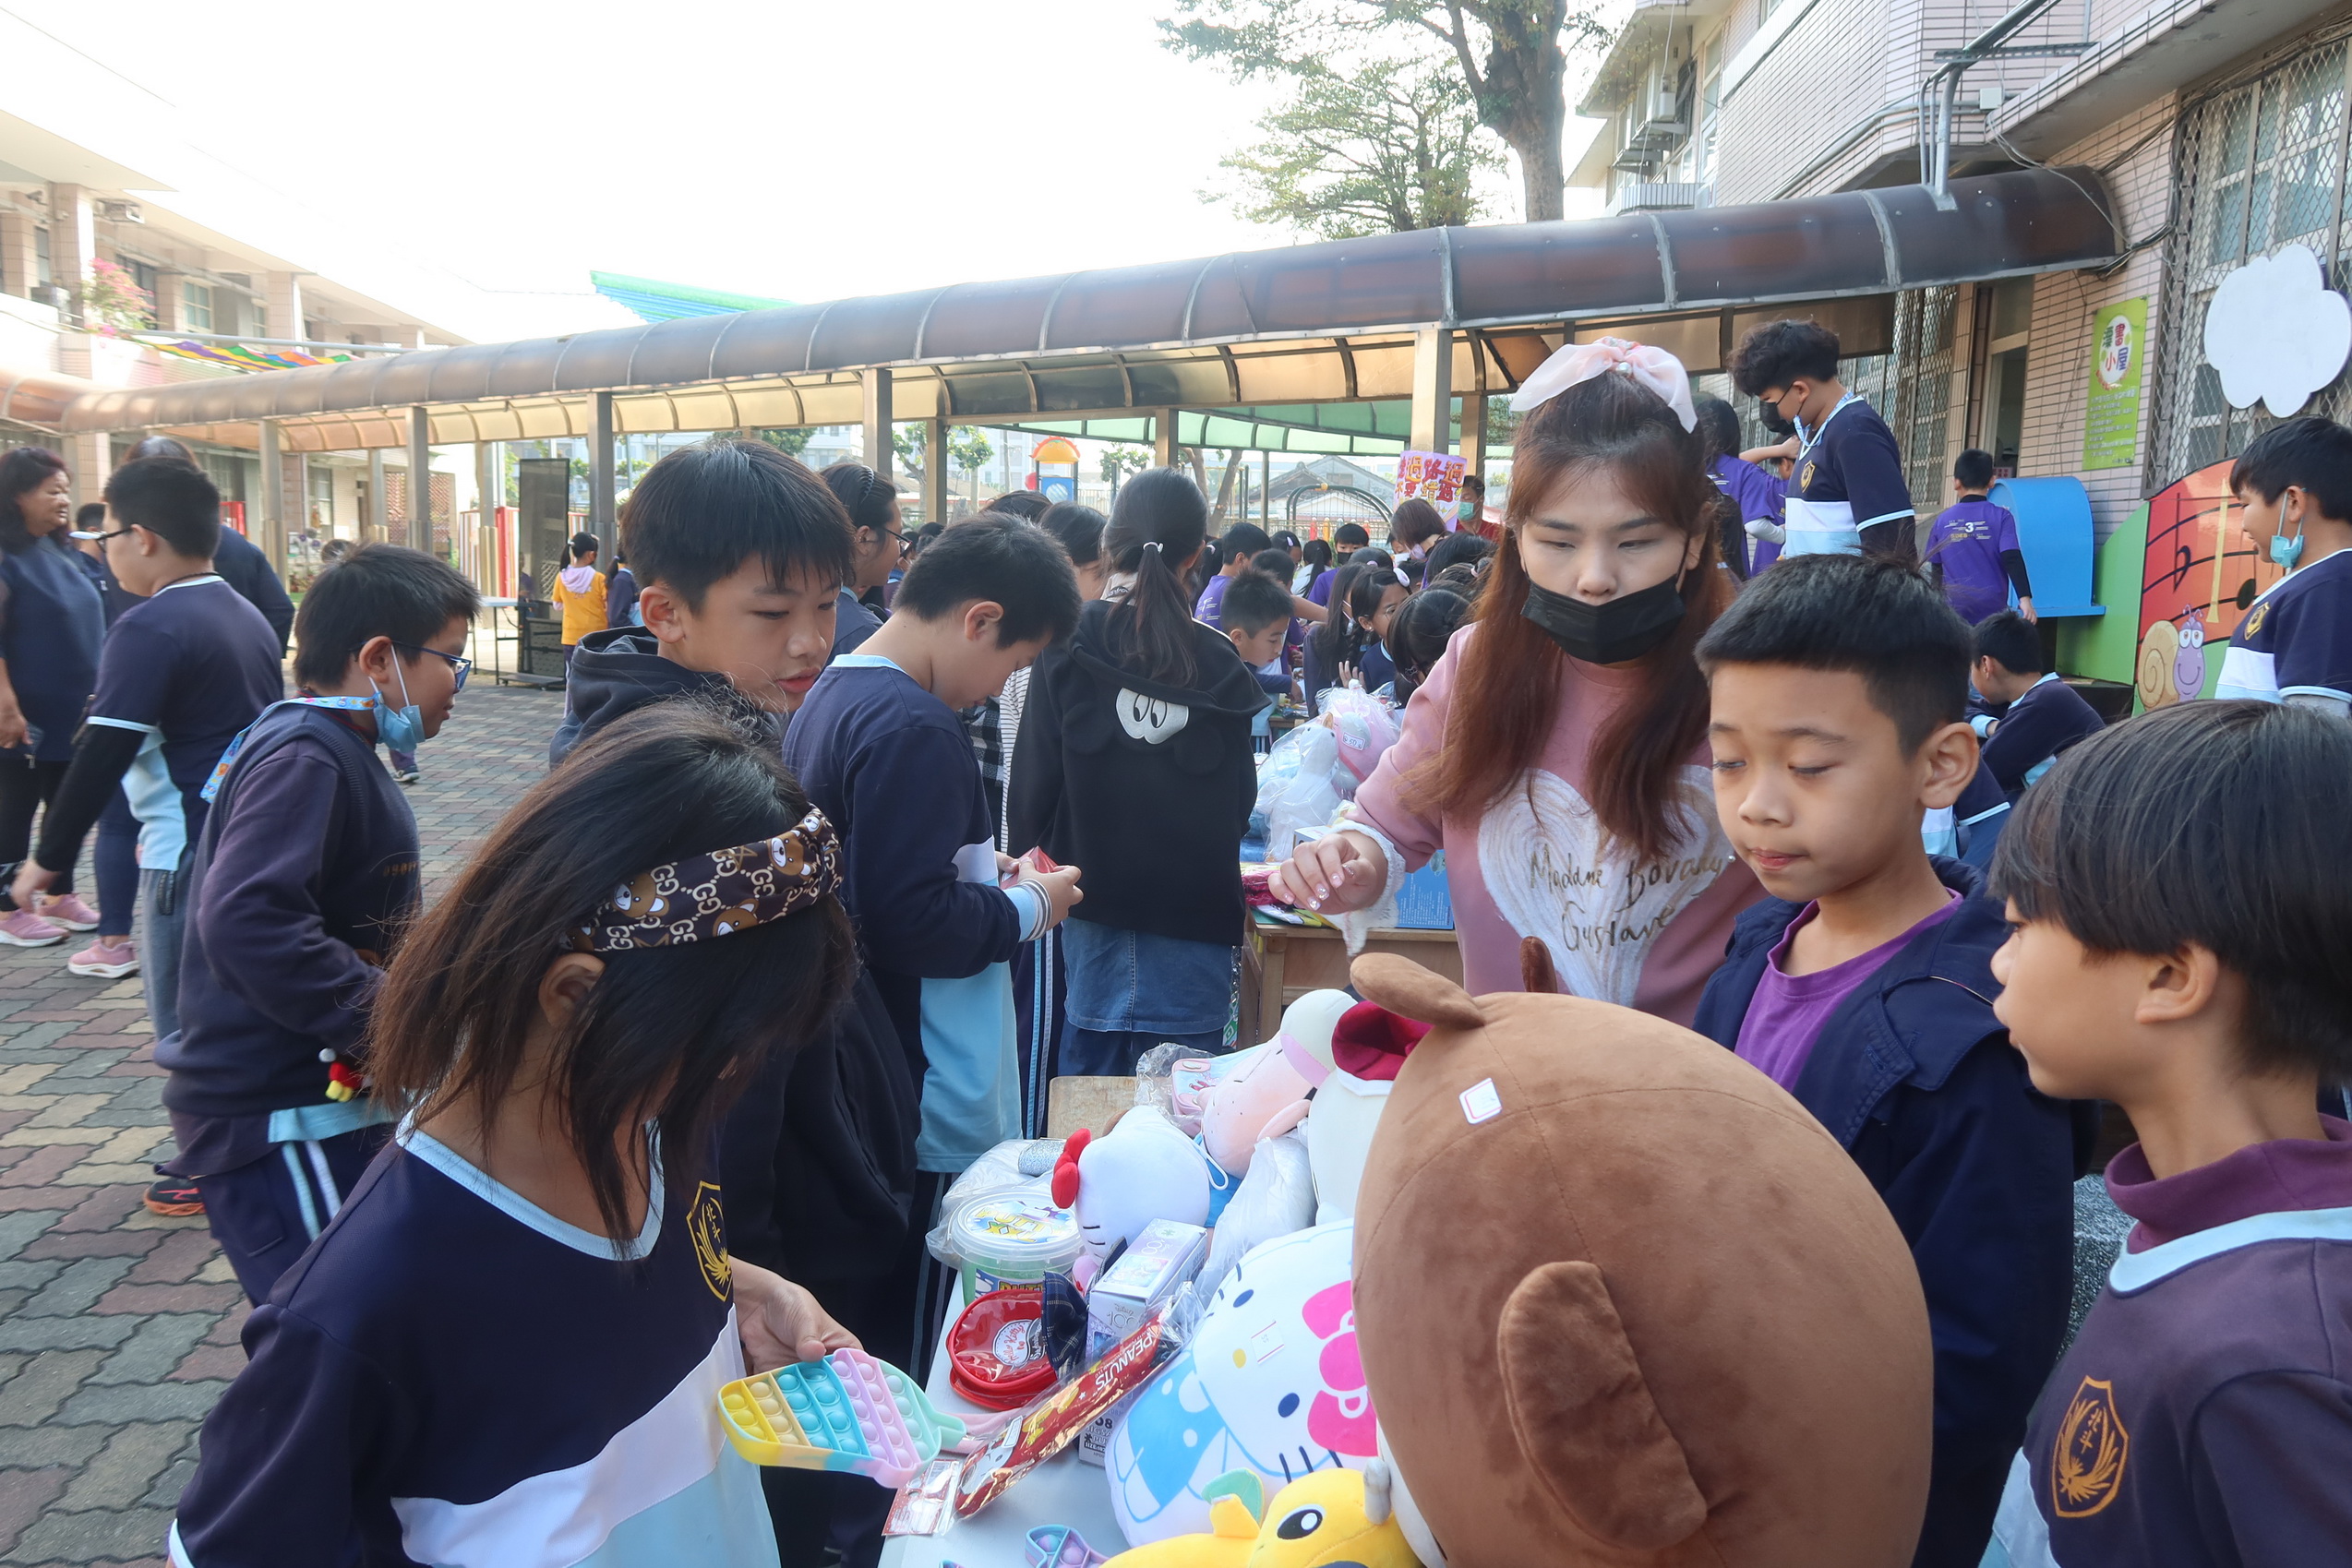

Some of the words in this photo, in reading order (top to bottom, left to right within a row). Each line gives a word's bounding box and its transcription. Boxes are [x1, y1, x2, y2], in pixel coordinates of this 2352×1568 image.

[1965, 521, 1974, 533] 3
[705, 1202, 722, 1244] 北斗
[1095, 1327, 1155, 1392] PEANUTS
[2079, 1407, 2102, 1454] 北斗
